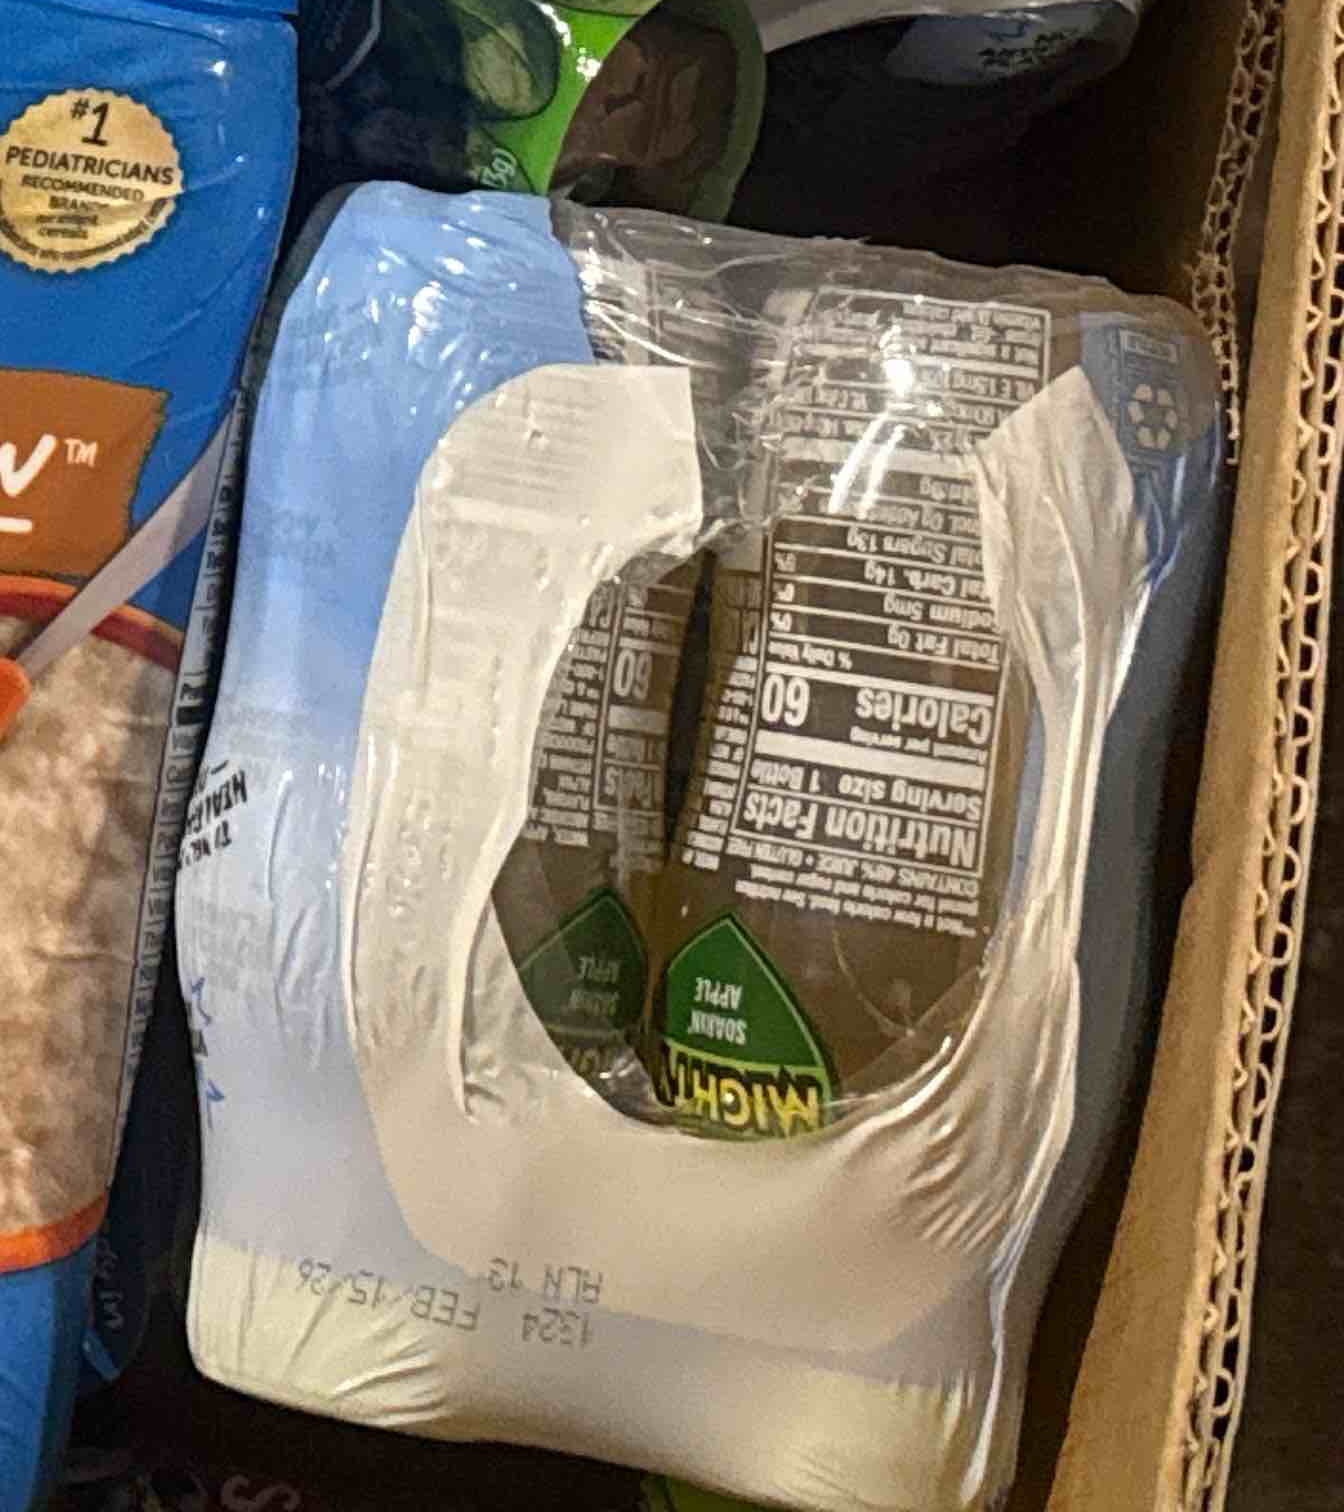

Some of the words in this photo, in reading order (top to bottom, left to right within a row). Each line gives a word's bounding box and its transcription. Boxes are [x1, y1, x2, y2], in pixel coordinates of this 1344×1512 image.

[69, 97, 109, 146] #1
[5, 145, 174, 185] PEDIATRICIANS
[761, 671, 812, 726] 60
[852, 686, 993, 744] Calories
[741, 791, 819, 839] Facts
[821, 805, 979, 868] Nutrition
[694, 976, 742, 1010] APPLE
